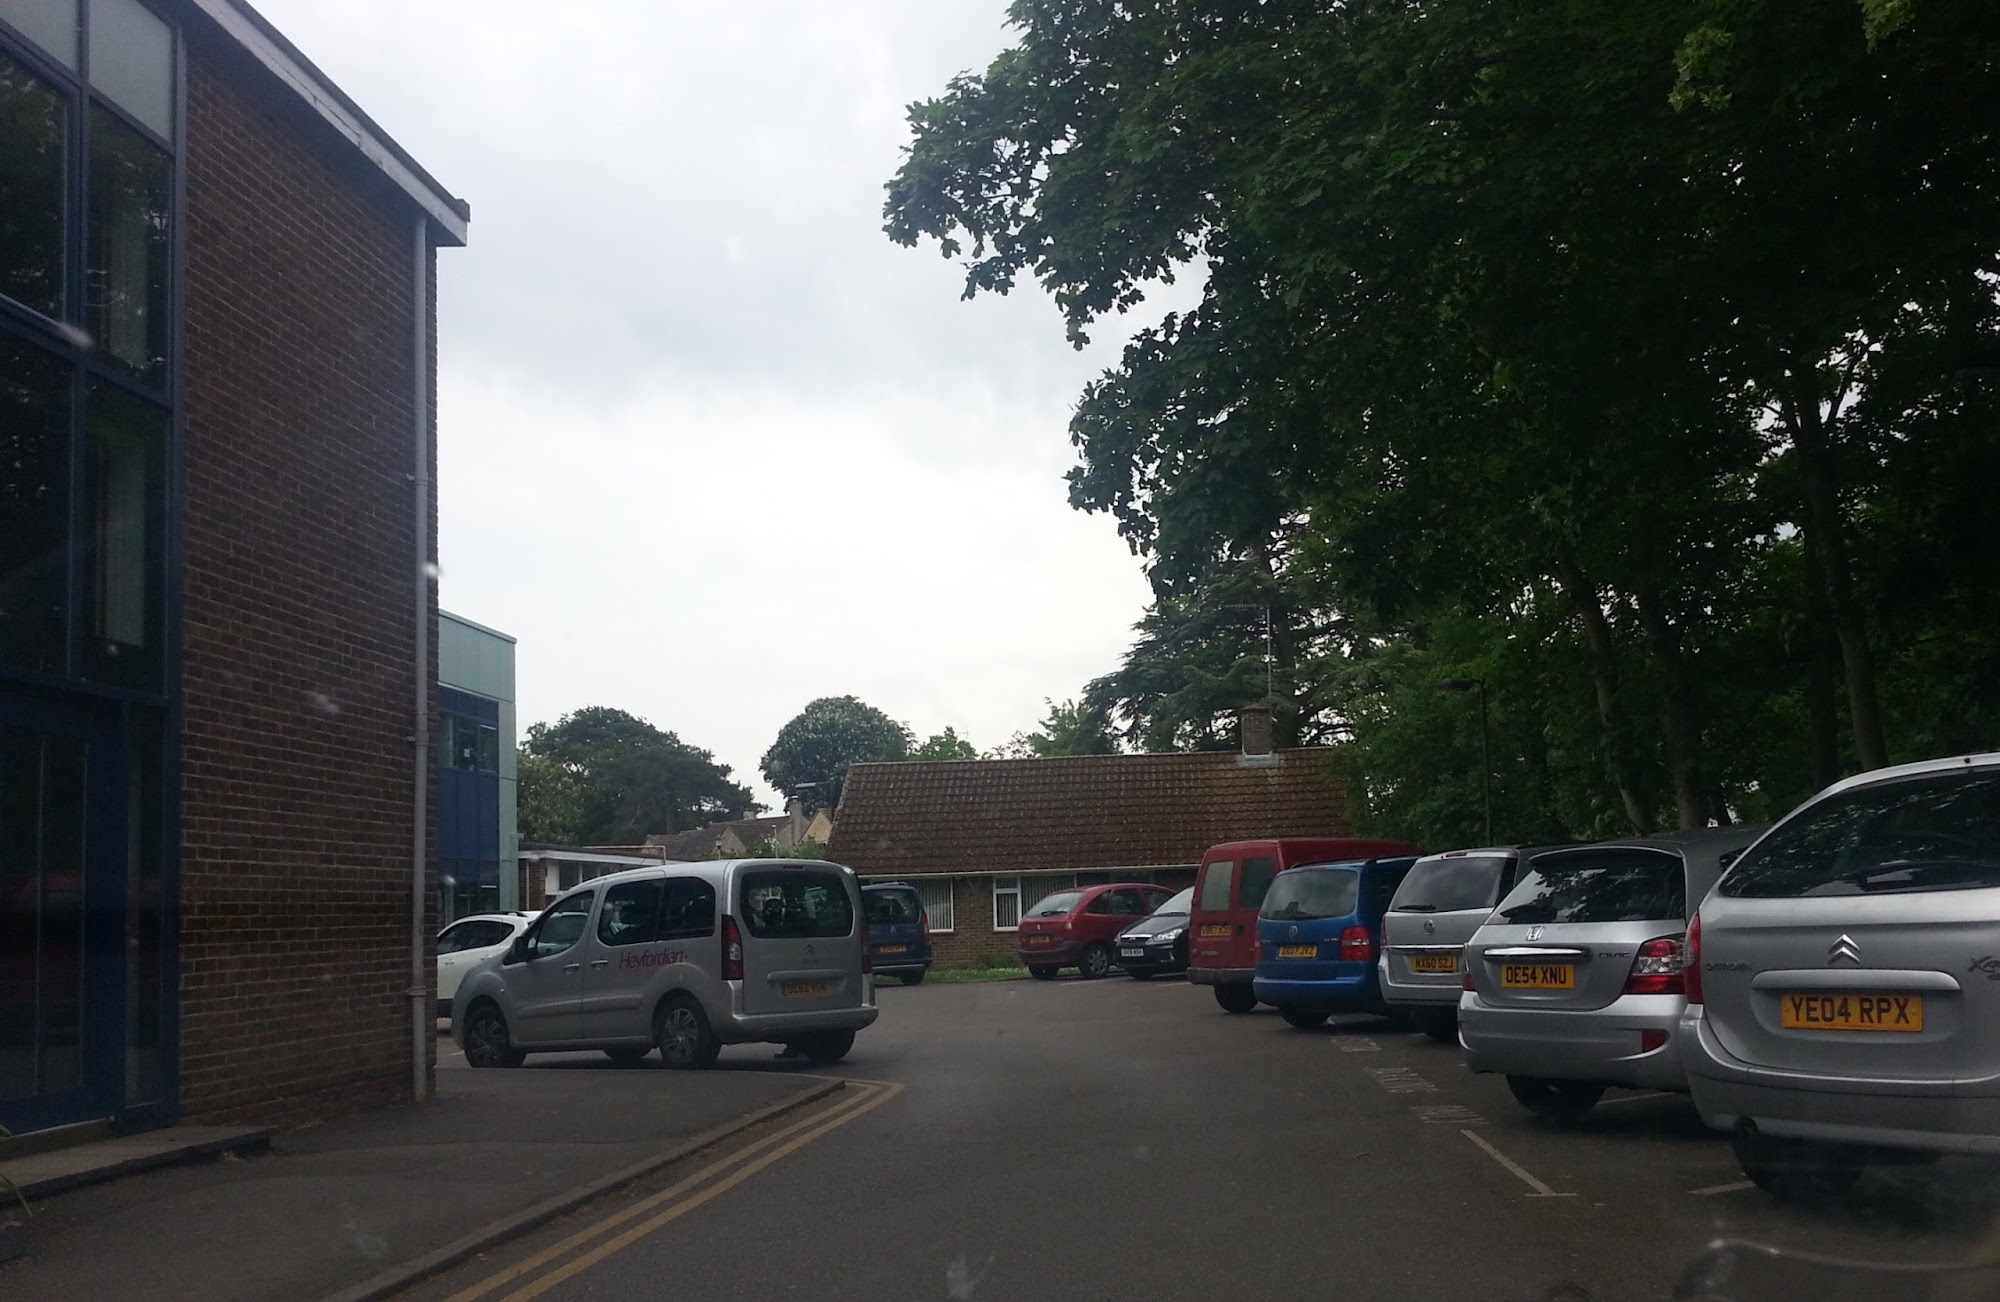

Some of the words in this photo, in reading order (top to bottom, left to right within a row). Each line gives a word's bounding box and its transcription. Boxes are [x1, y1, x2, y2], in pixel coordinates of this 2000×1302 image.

[619, 948, 684, 970] Heyfordian
[1506, 966, 1537, 984] OE54
[1541, 967, 1567, 984] XNU
[1791, 996, 1851, 1023] YE04
[1859, 998, 1910, 1025] RPX
